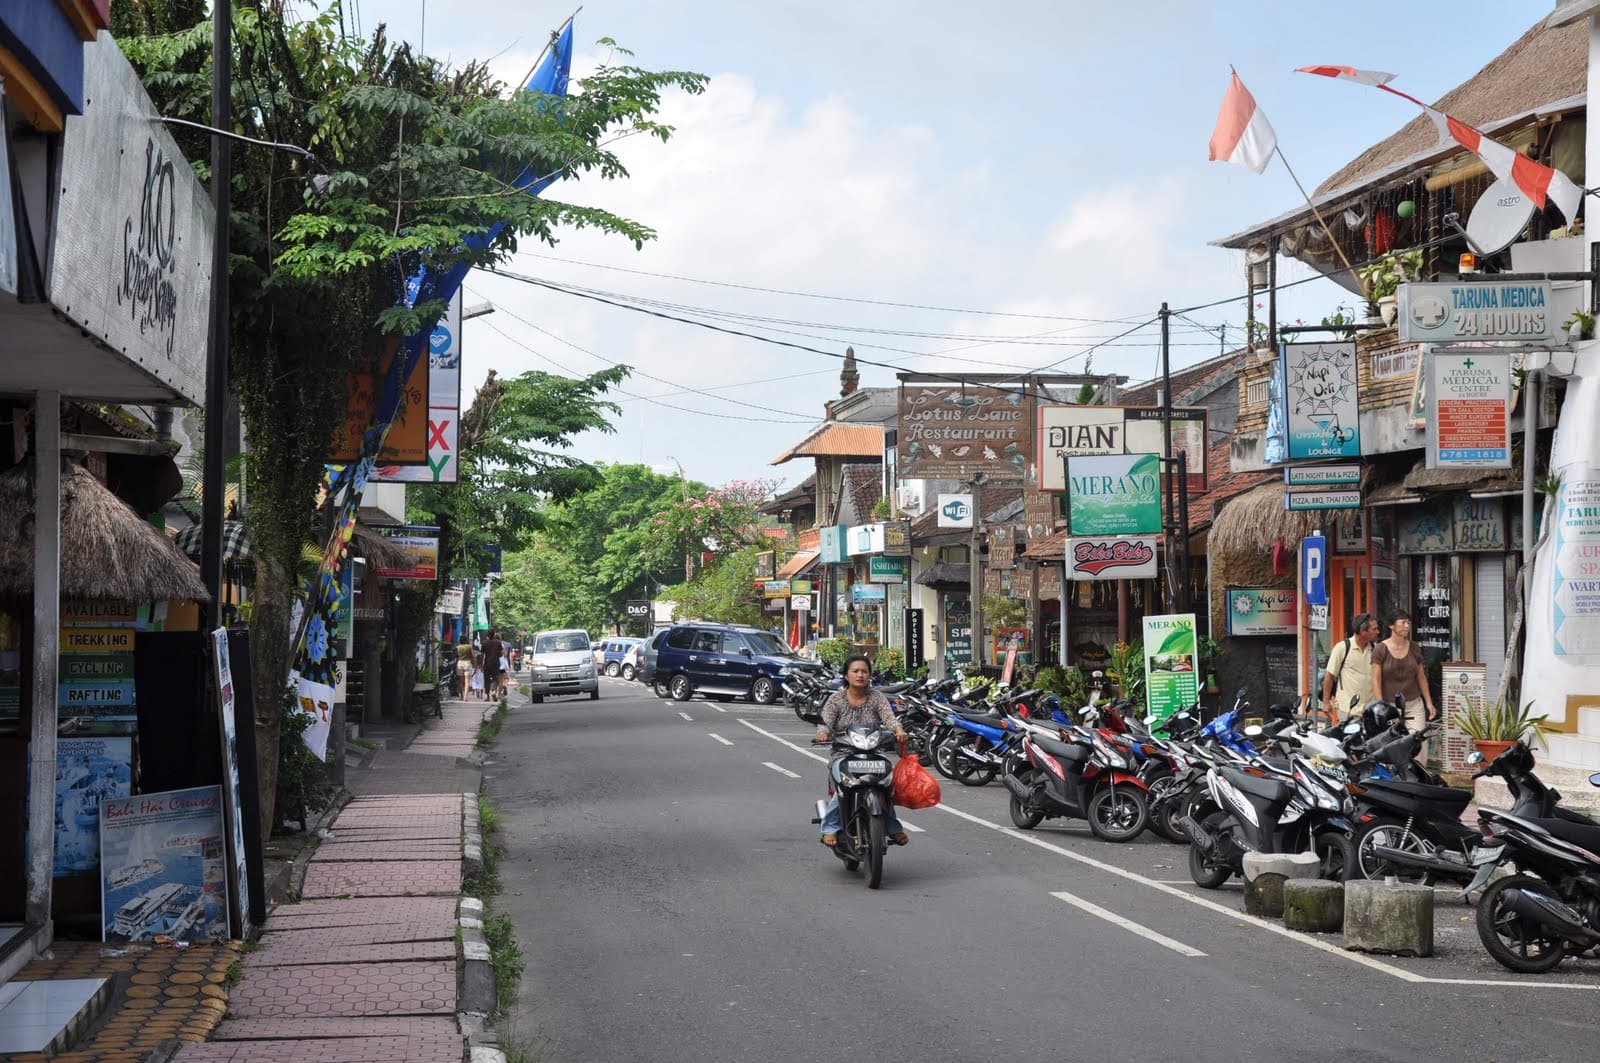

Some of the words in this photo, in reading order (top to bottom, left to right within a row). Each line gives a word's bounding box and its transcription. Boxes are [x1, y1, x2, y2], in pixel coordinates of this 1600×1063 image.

[1497, 196, 1520, 207] astro
[1452, 288, 1498, 309] TARUNA
[1501, 286, 1545, 308] MEDICA
[1454, 313, 1477, 336] 24
[1481, 311, 1545, 335] HOURS
[1307, 365, 1330, 382] Napi
[904, 396, 962, 421] Lotus
[968, 396, 1021, 421] Lane
[905, 420, 1017, 441] Restaurant
[1308, 448, 1342, 456] LOUNGE
[1072, 474, 1156, 496] MERANO
[1307, 548, 1321, 595] P
[66, 605, 130, 616] AVAILABLE
[1429, 606, 1450, 618] CENTER
[1148, 619, 1192, 630] MERANO
[68, 634, 128, 646] TREKKING
[70, 662, 122, 673] CYCLING
[69, 689, 121, 700] RAFTING
[106, 803, 133, 818] Bali
[140, 800, 164, 815] Hai
